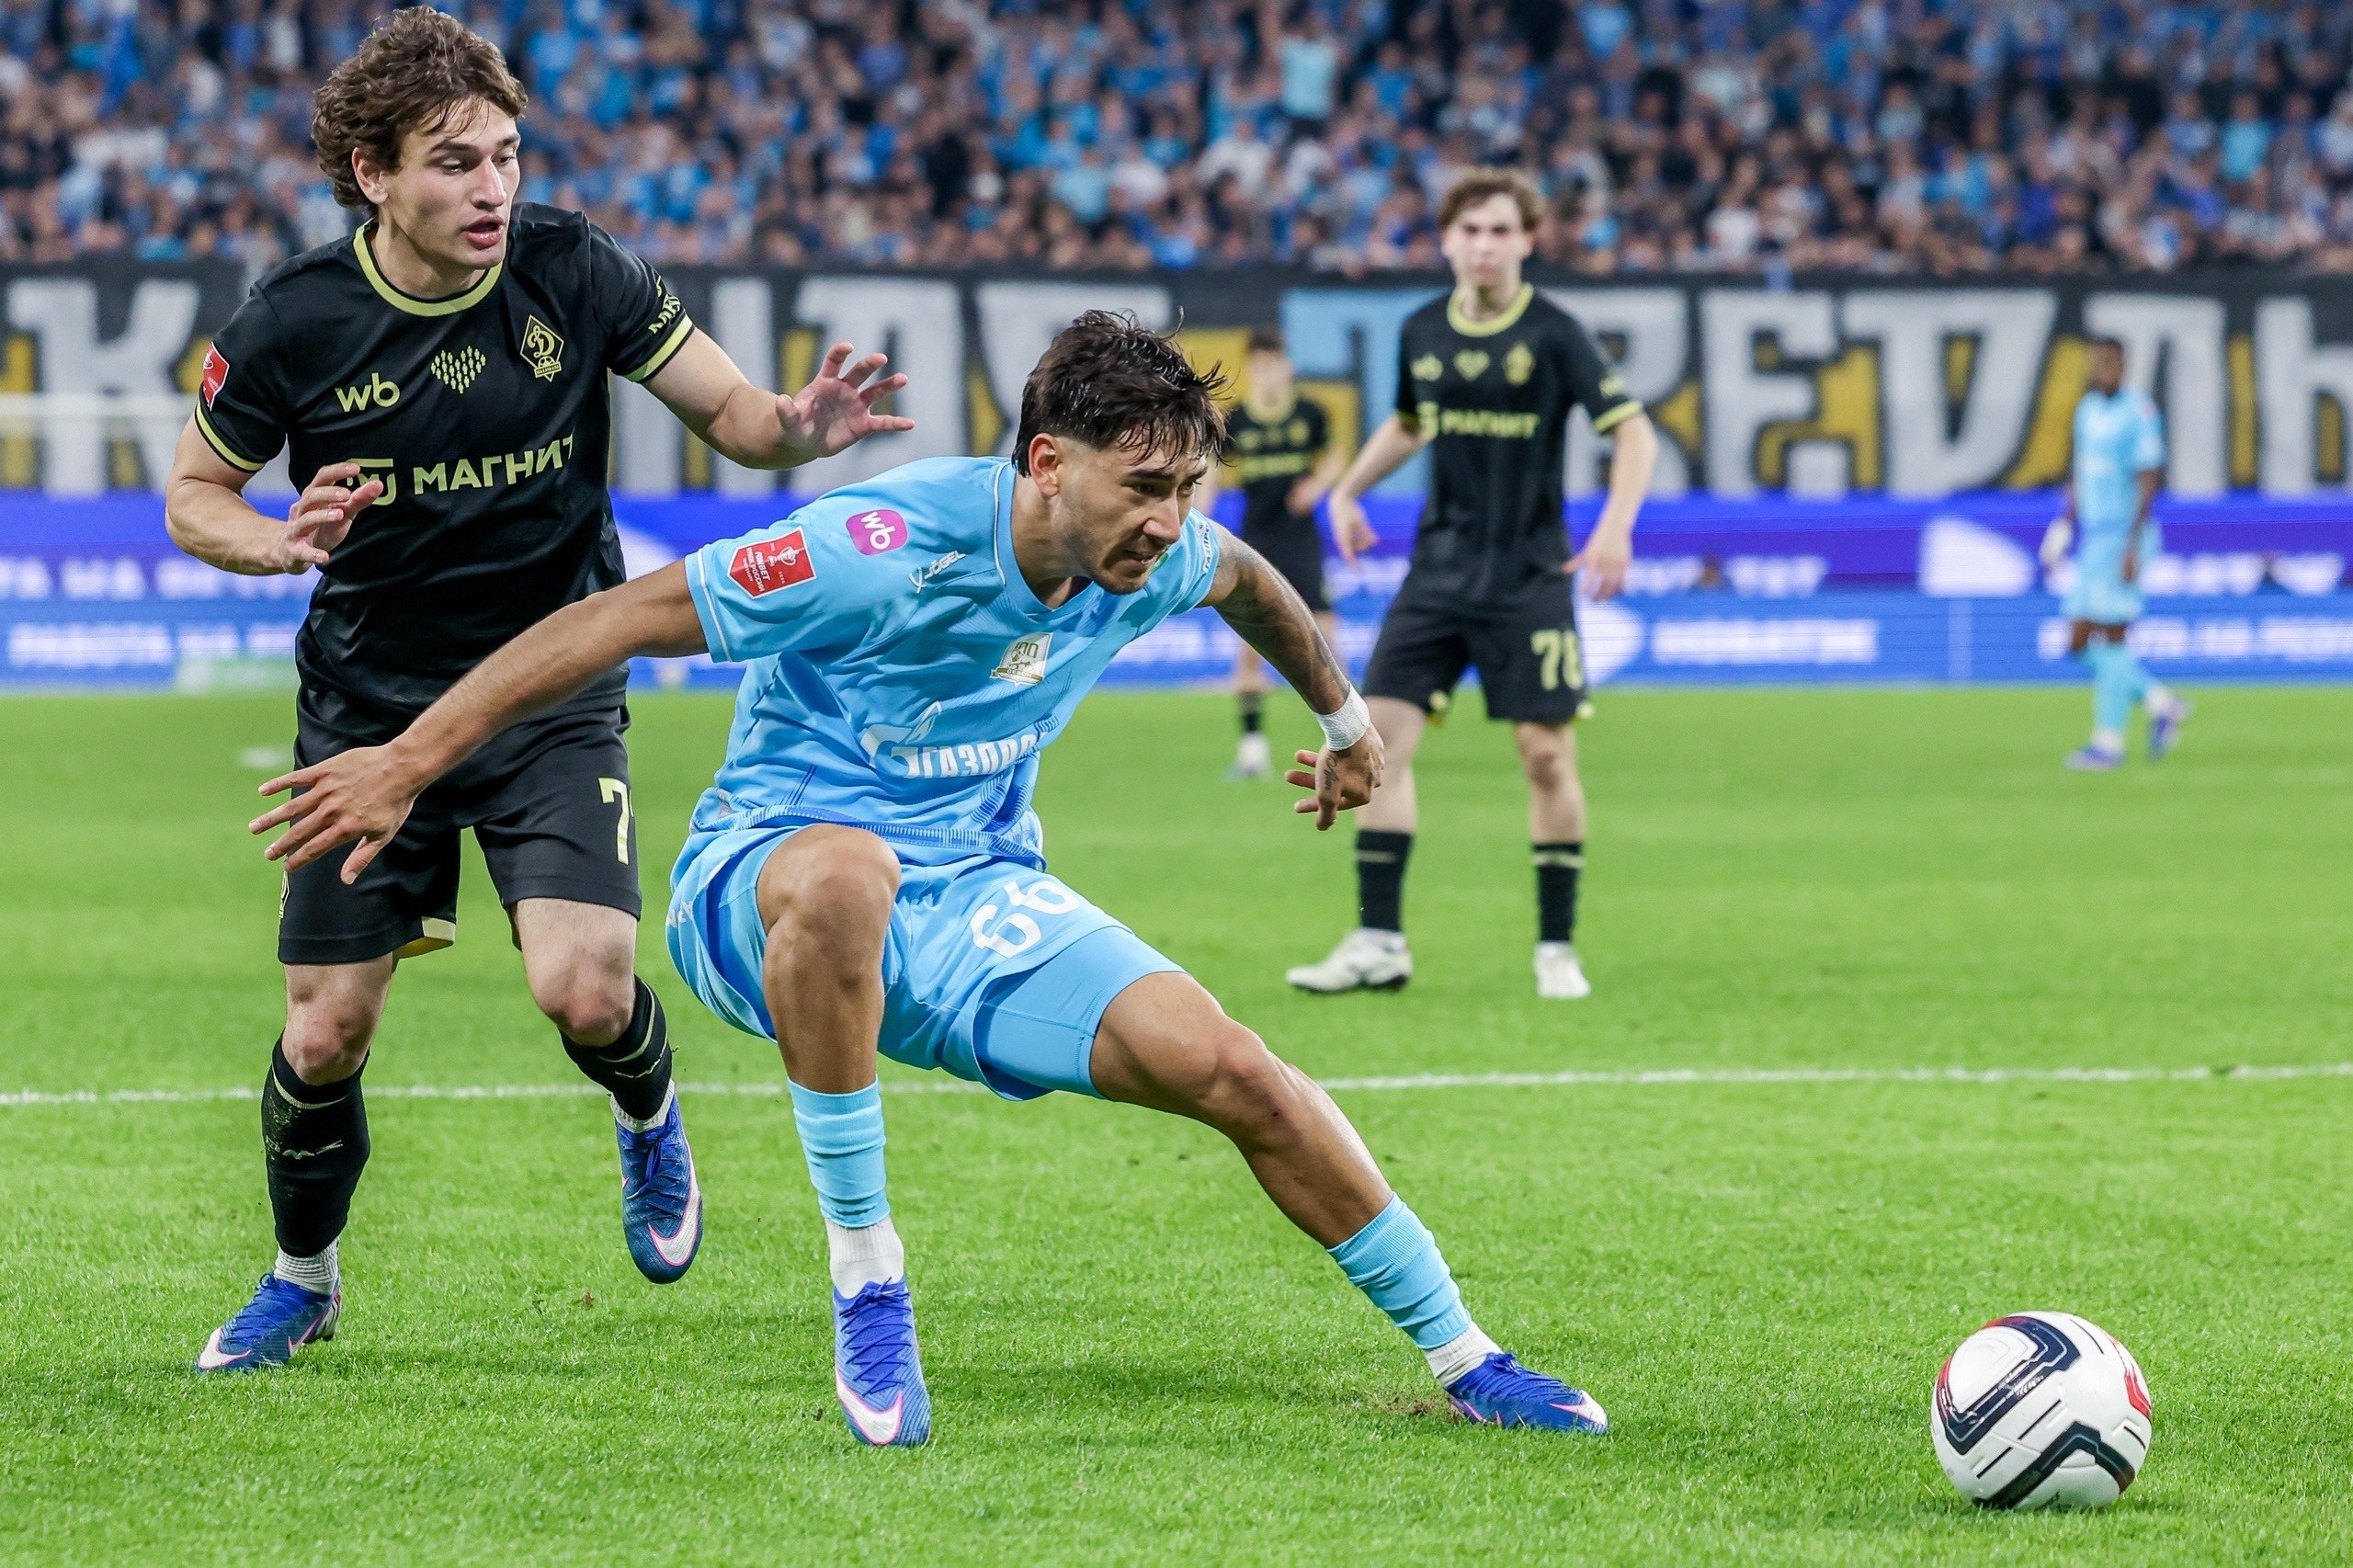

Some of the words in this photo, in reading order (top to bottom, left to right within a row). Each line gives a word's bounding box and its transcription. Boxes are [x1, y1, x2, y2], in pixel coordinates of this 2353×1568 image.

[335, 372, 401, 413] wb
[860, 511, 896, 551] wb
[970, 881, 1082, 959] 66
